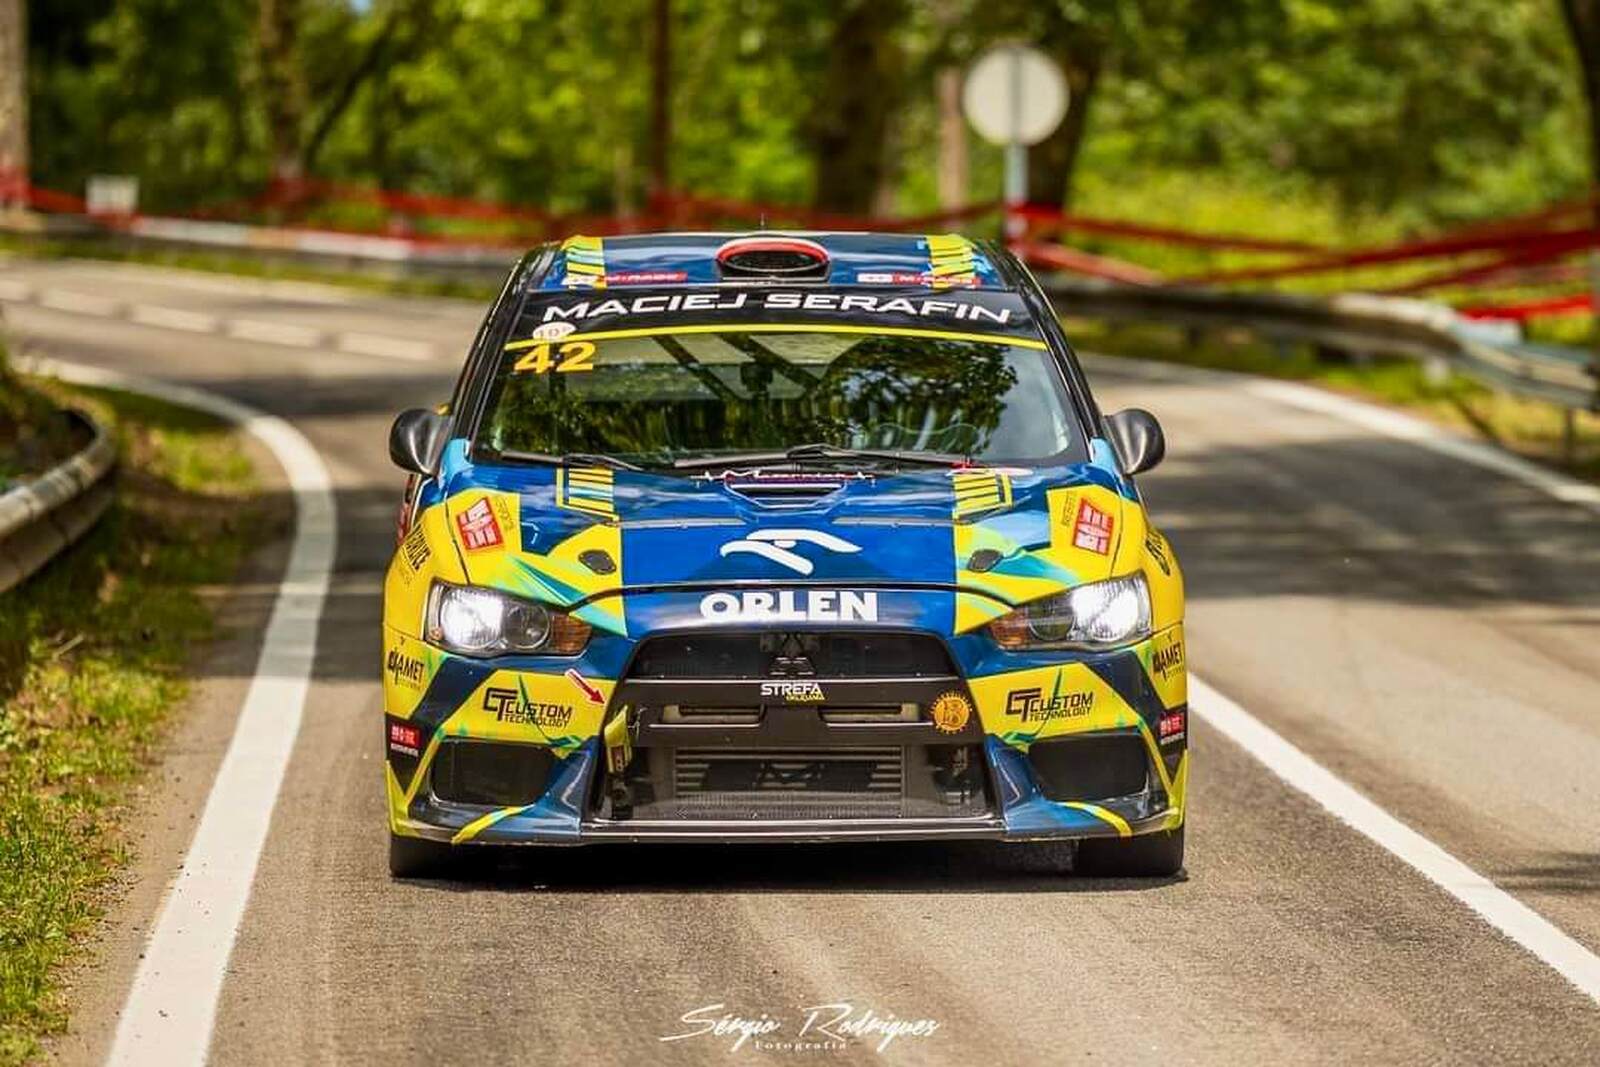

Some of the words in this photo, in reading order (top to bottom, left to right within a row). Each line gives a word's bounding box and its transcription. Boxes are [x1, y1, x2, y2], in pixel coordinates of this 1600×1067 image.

[543, 292, 748, 322] MACIEJ
[763, 292, 1012, 324] SERAFIN
[514, 342, 595, 373] 42
[700, 591, 879, 623] ORLEN
[760, 682, 823, 697] STREFA
[505, 701, 573, 720] CUSTOM
[1030, 691, 1093, 712] CUSTOM
[504, 714, 571, 728] TECHNOLOGY
[1029, 707, 1092, 721] TECHNOLOGY
